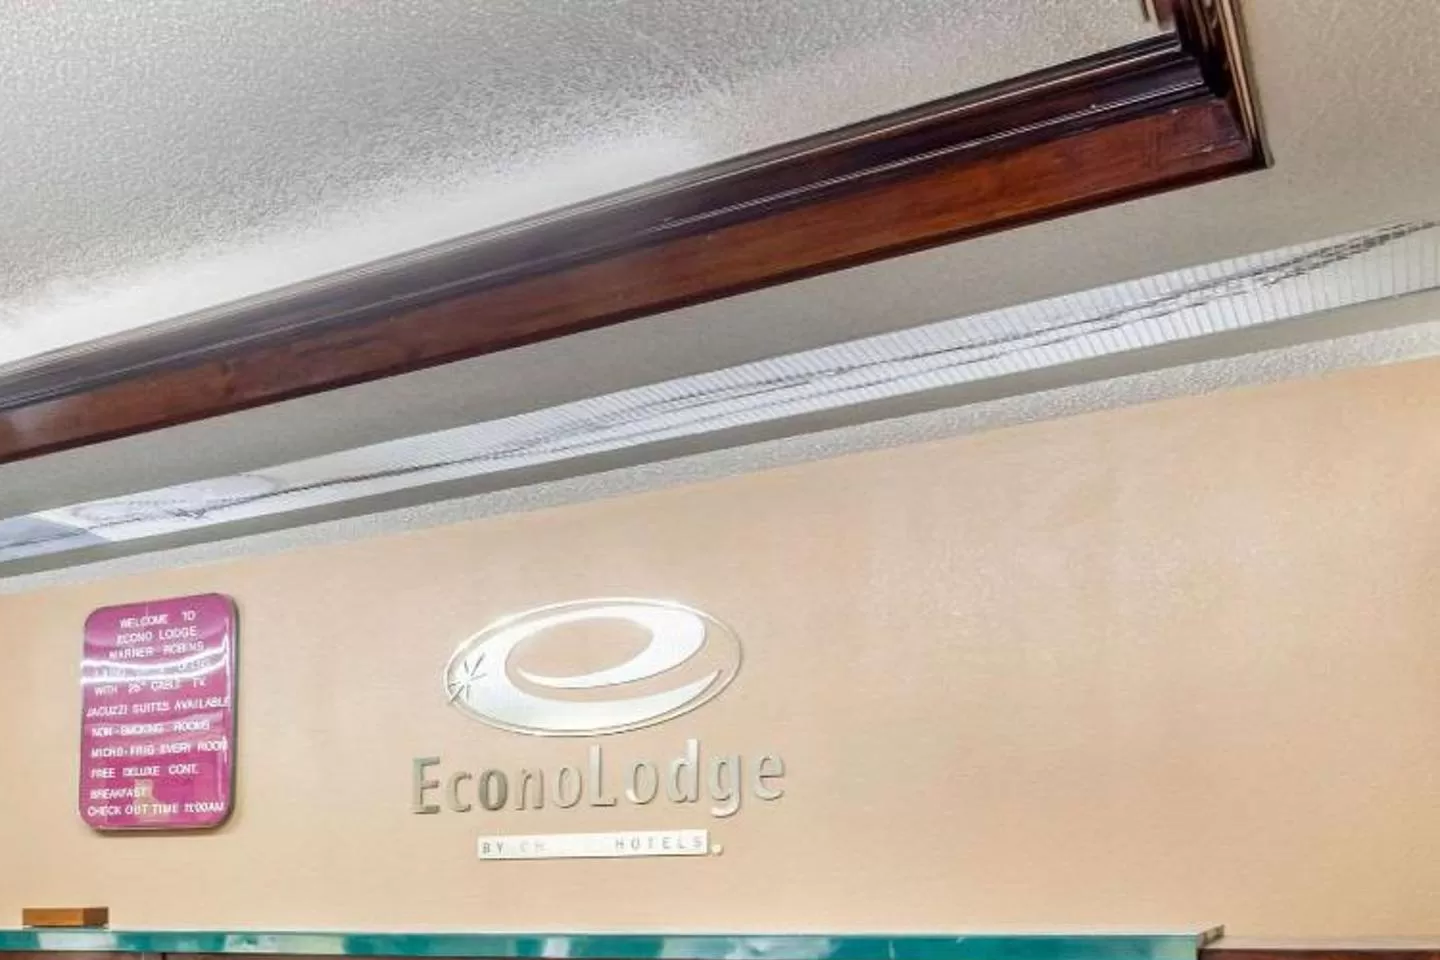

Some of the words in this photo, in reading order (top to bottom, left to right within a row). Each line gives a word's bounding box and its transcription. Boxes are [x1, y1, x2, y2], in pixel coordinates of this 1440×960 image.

[119, 613, 168, 629] WELCOME
[182, 610, 196, 621] TO
[116, 631, 153, 644] ECONO
[159, 625, 197, 640] LODGE
[94, 684, 118, 696] WITH
[132, 700, 170, 714] SUITES
[174, 696, 230, 711] AVAILABLE
[174, 720, 211, 733] ROOMS
[160, 741, 191, 756] EVERY
[90, 766, 116, 779] FREE
[123, 765, 160, 777] DELUXE
[411, 738, 786, 818] EconoLodge
[90, 786, 147, 800] BREAKFAST
[87, 804, 121, 817] CHECK
[125, 803, 147, 816] OUT
[151, 802, 178, 814] TIME
[482, 840, 505, 855] BY
